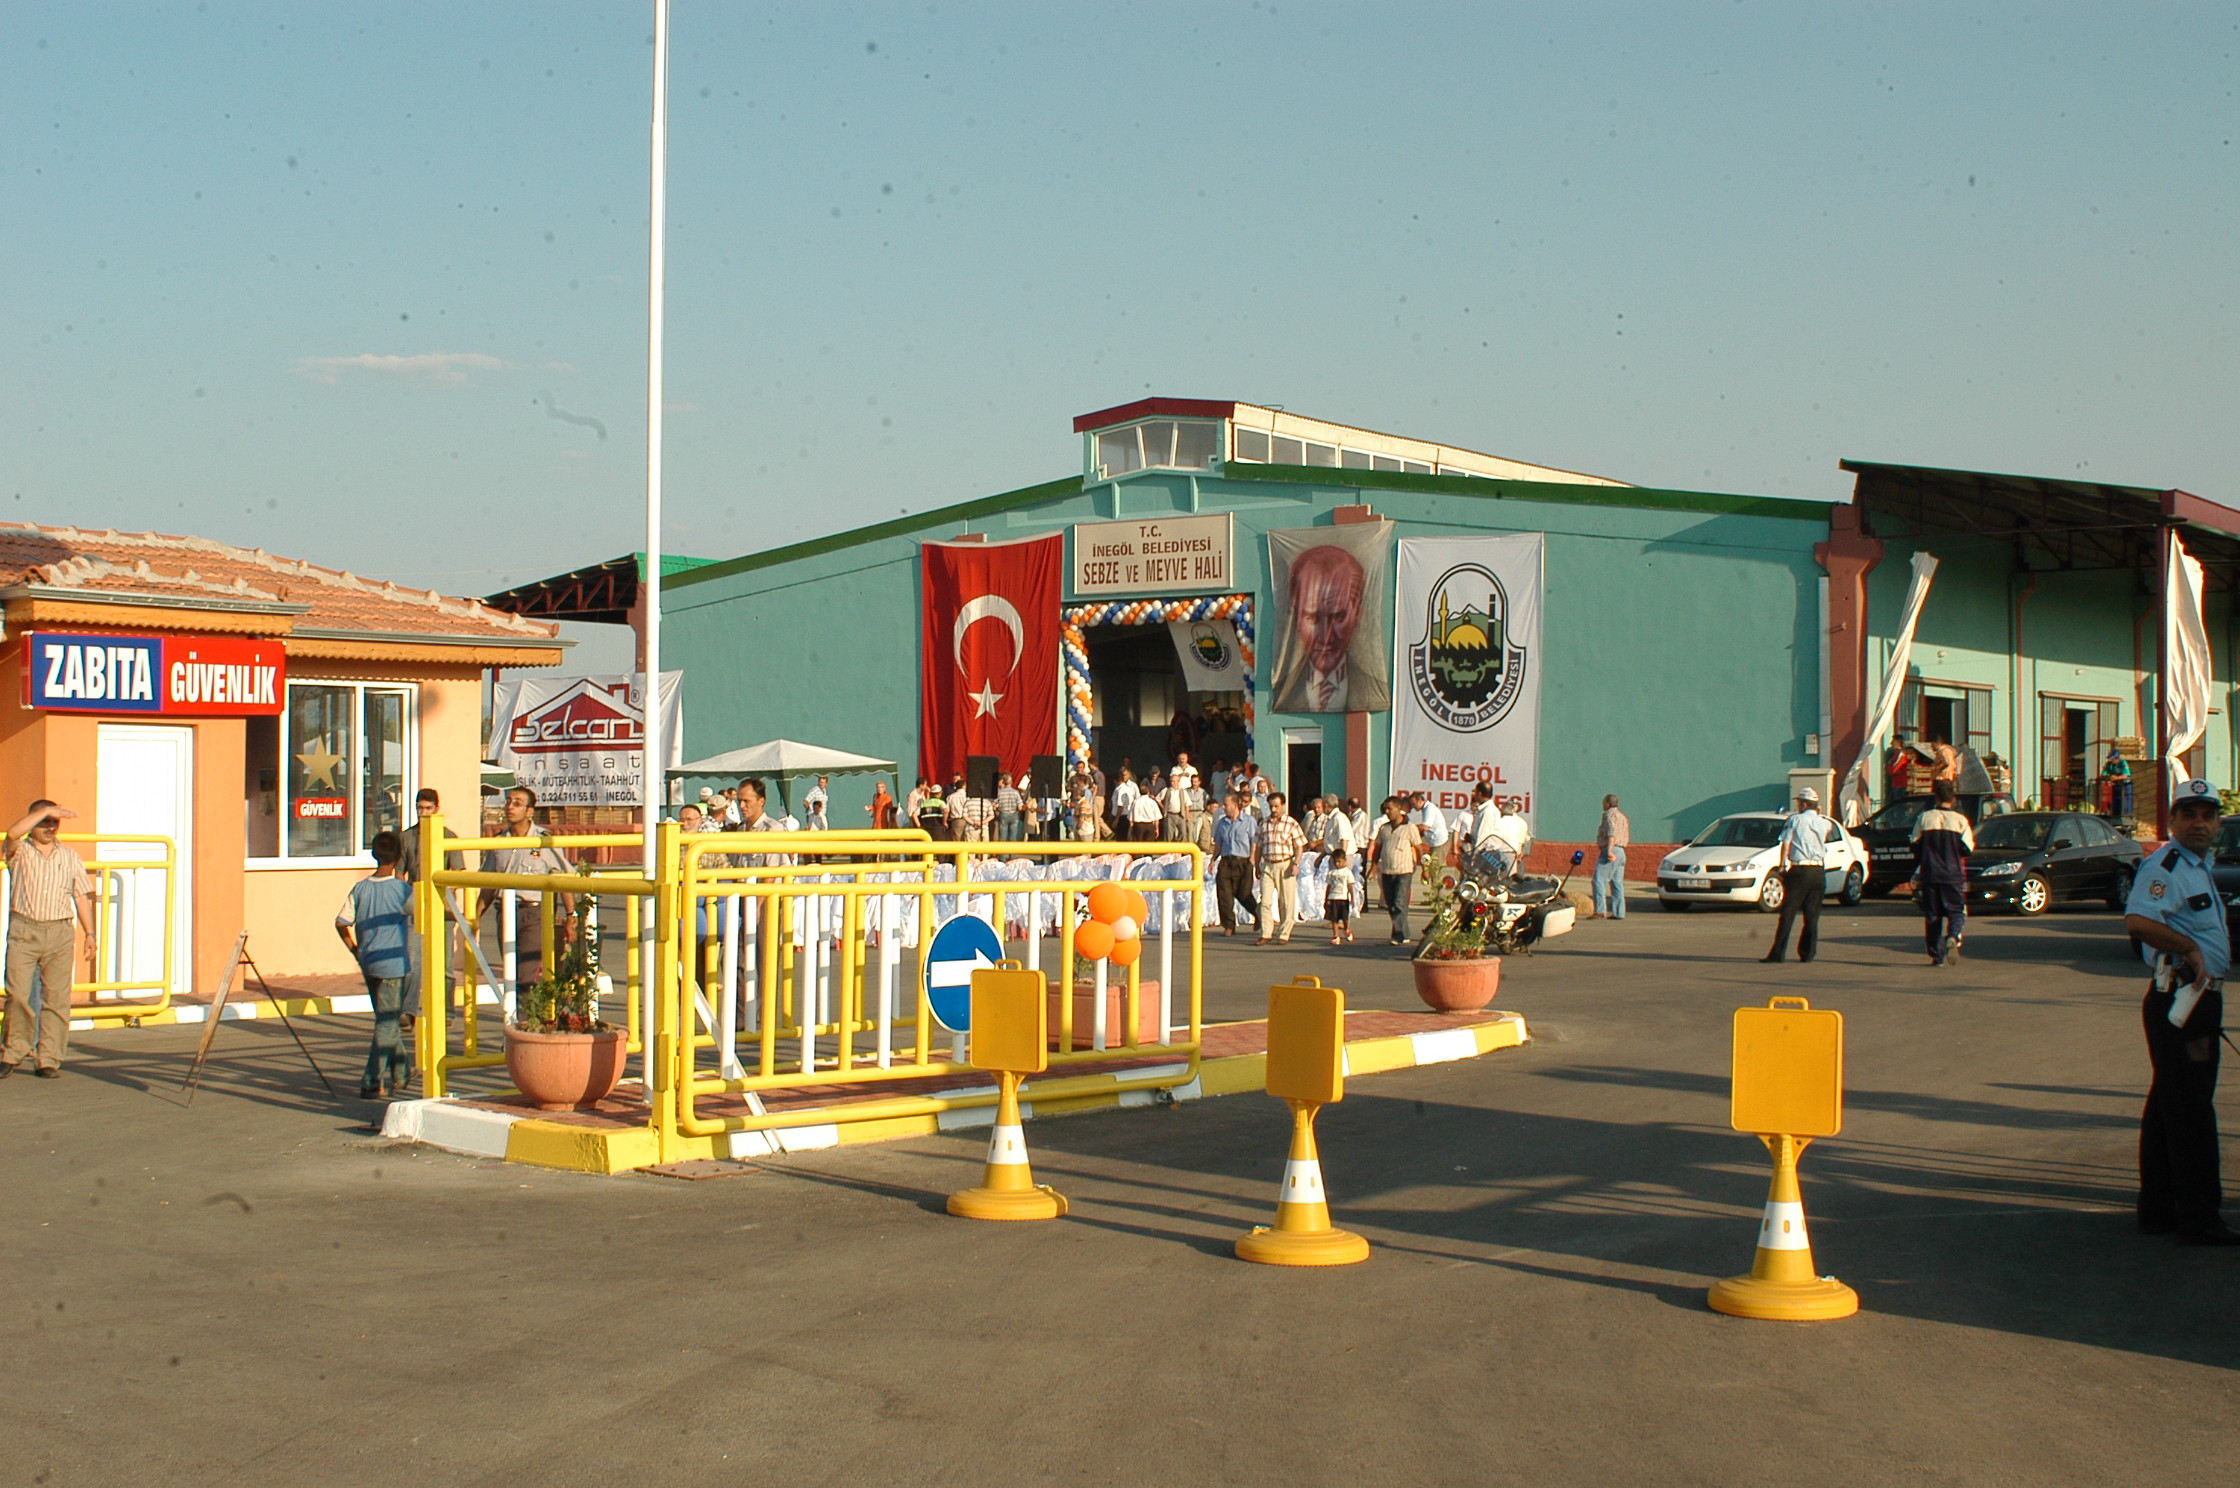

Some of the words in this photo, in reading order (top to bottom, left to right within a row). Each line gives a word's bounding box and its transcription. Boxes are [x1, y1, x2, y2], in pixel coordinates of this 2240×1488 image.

[1139, 525, 1162, 538] T.C.
[1093, 541, 1135, 557] İNEGÖL
[1142, 536, 1211, 555] BELEDİYESİ
[1083, 561, 1119, 585] SEBZE
[1126, 565, 1139, 583] VE
[1146, 557, 1187, 582] MEYVE
[1195, 551, 1222, 580] HALİ
[44, 644, 153, 700] ZABITA
[170, 651, 276, 704] GÜVENLİK
[1453, 715, 1475, 726] 1870
[600, 771, 641, 786] TAAHHÜT
[1421, 758, 1507, 784] İNEGÖL
[606, 788, 637, 802] İNEGÖL
[299, 800, 344, 817] GÜVENLİK
